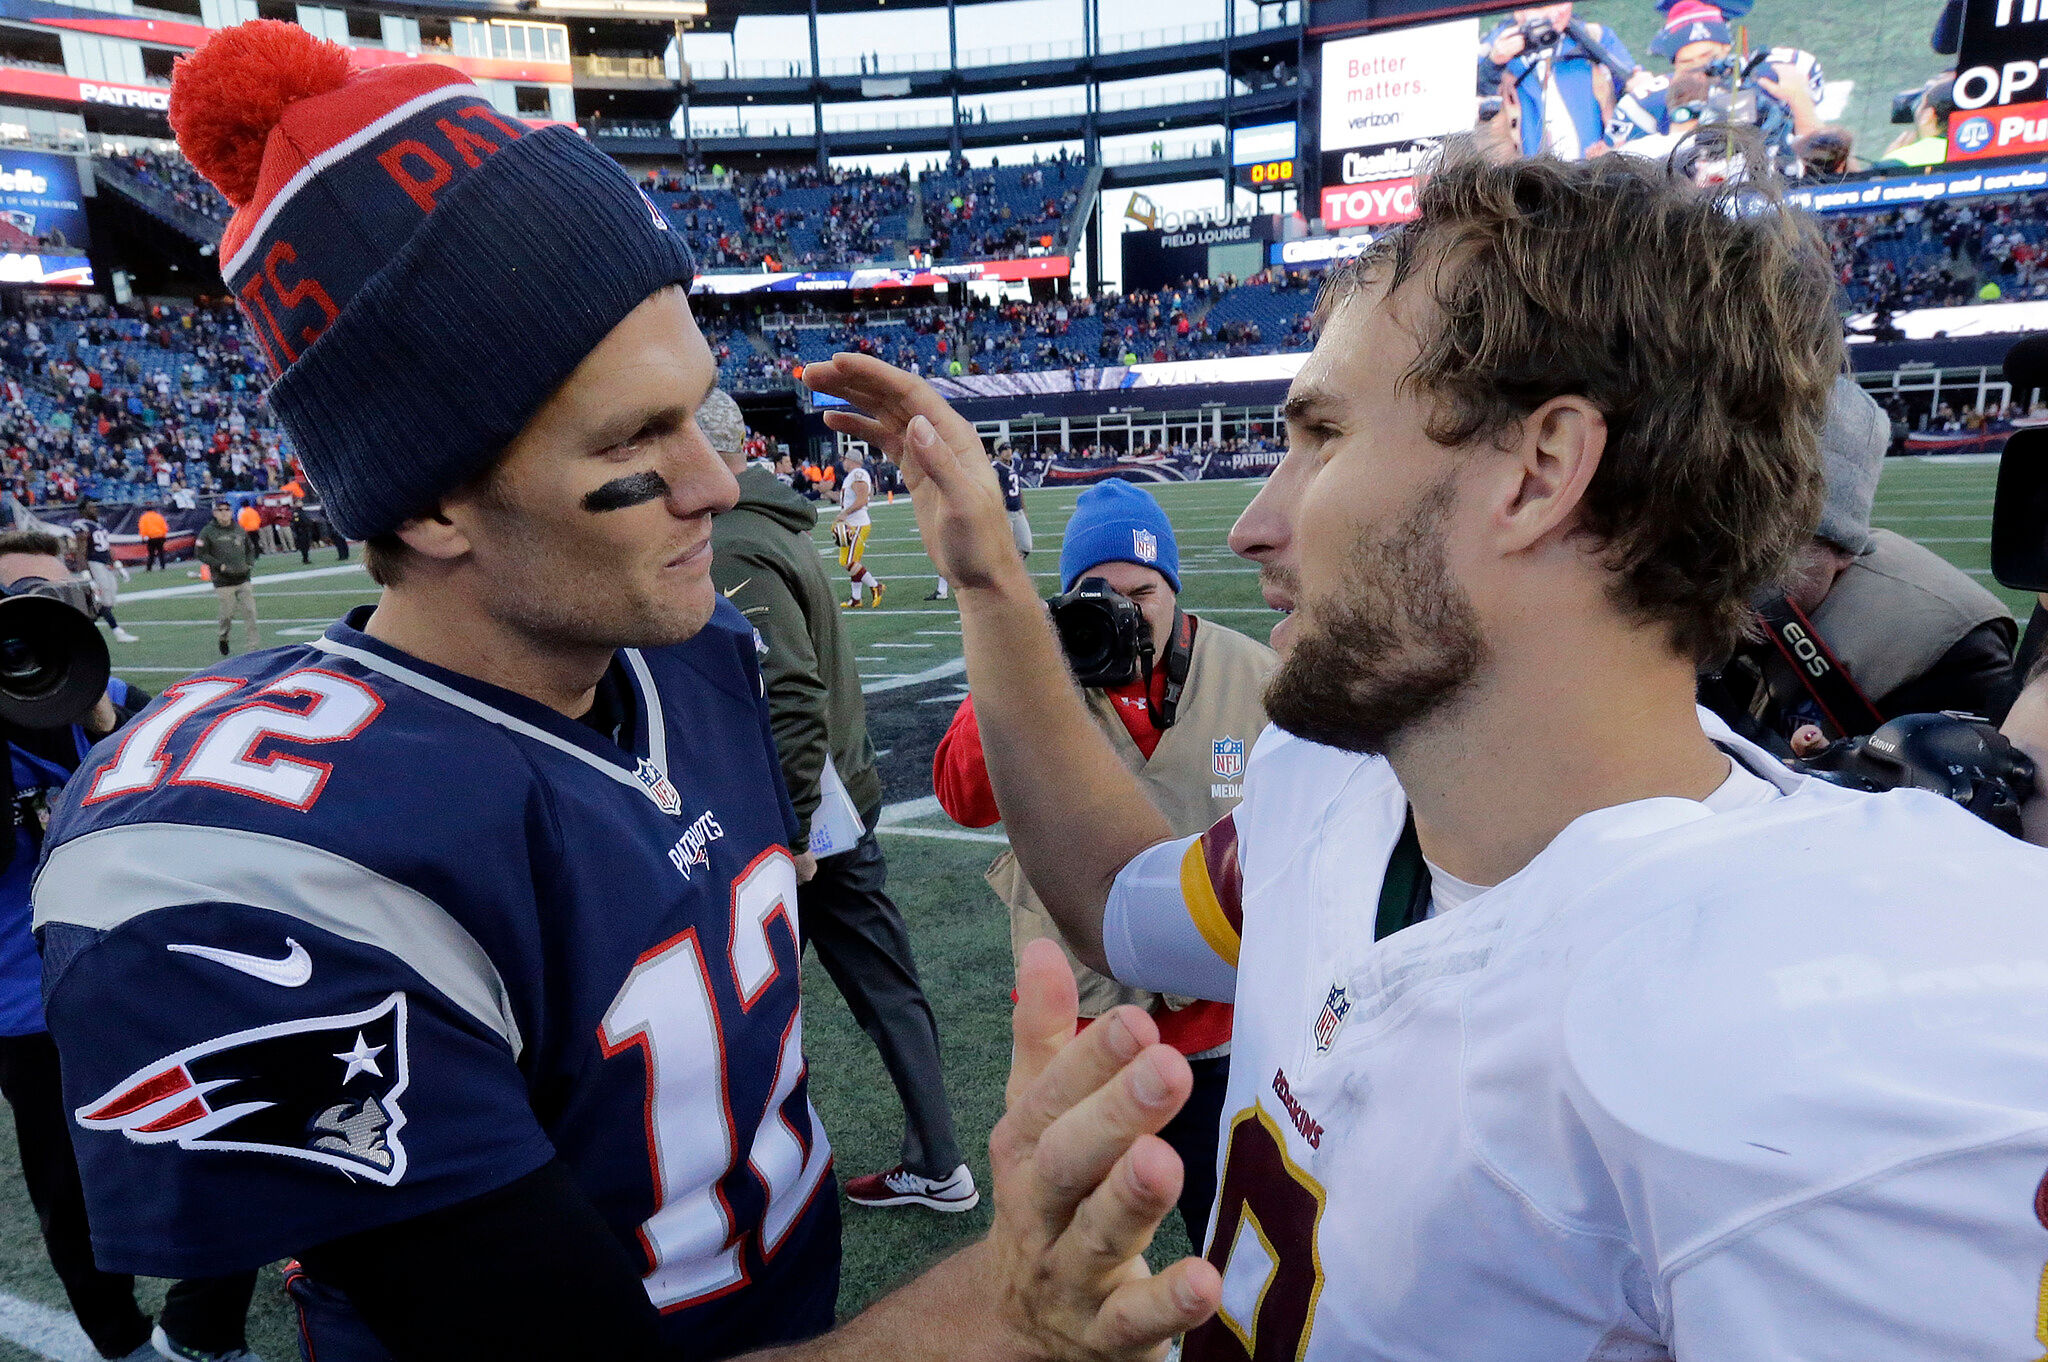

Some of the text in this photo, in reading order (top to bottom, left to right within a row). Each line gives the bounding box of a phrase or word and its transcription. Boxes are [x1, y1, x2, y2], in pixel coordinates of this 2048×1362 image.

[1348, 56, 1407, 79] Better
[79, 83, 170, 110] PATRIO
[1347, 79, 1428, 103] matters.
[1348, 111, 1401, 130] verizon
[1325, 186, 1416, 222] TOYO
[1161, 225, 1252, 249] FIELD LOUNGE
[1232, 451, 1287, 470] PATRIOT
[1782, 621, 1830, 678] EOS
[81, 668, 387, 813] 12
[1868, 735, 1896, 753] Canon
[1215, 754, 1241, 774] NFL
[667, 809, 725, 881] PATRIOTS
[1316, 1006, 1338, 1046] NFL
[596, 843, 834, 1316] 12
[1271, 1066, 1325, 1151] REDSKINS
